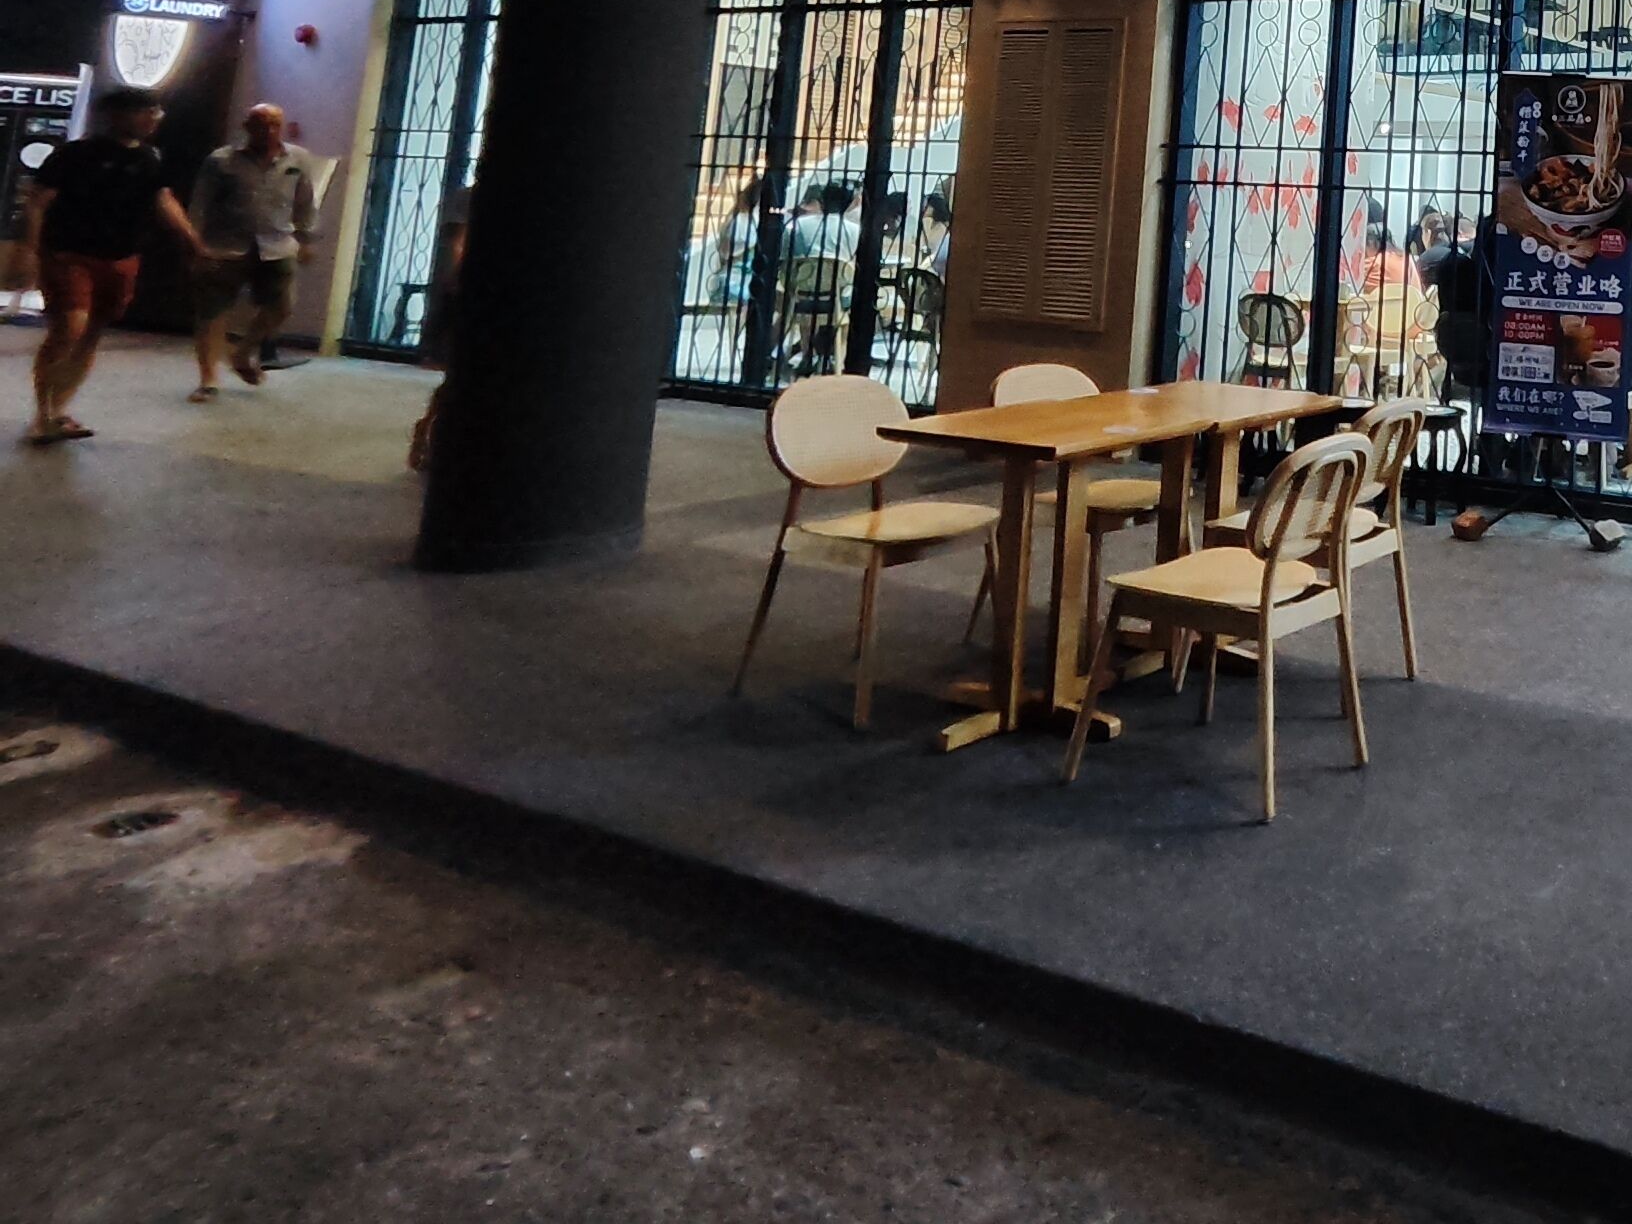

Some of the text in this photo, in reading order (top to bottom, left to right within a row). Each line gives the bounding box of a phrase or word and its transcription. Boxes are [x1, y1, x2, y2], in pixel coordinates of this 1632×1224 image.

[35, 88, 78, 107] LIS
[1503, 270, 1623, 299] 正式营业咯
[1555, 301, 1579, 310] OPEN
[1582, 302, 1605, 311] NOW
